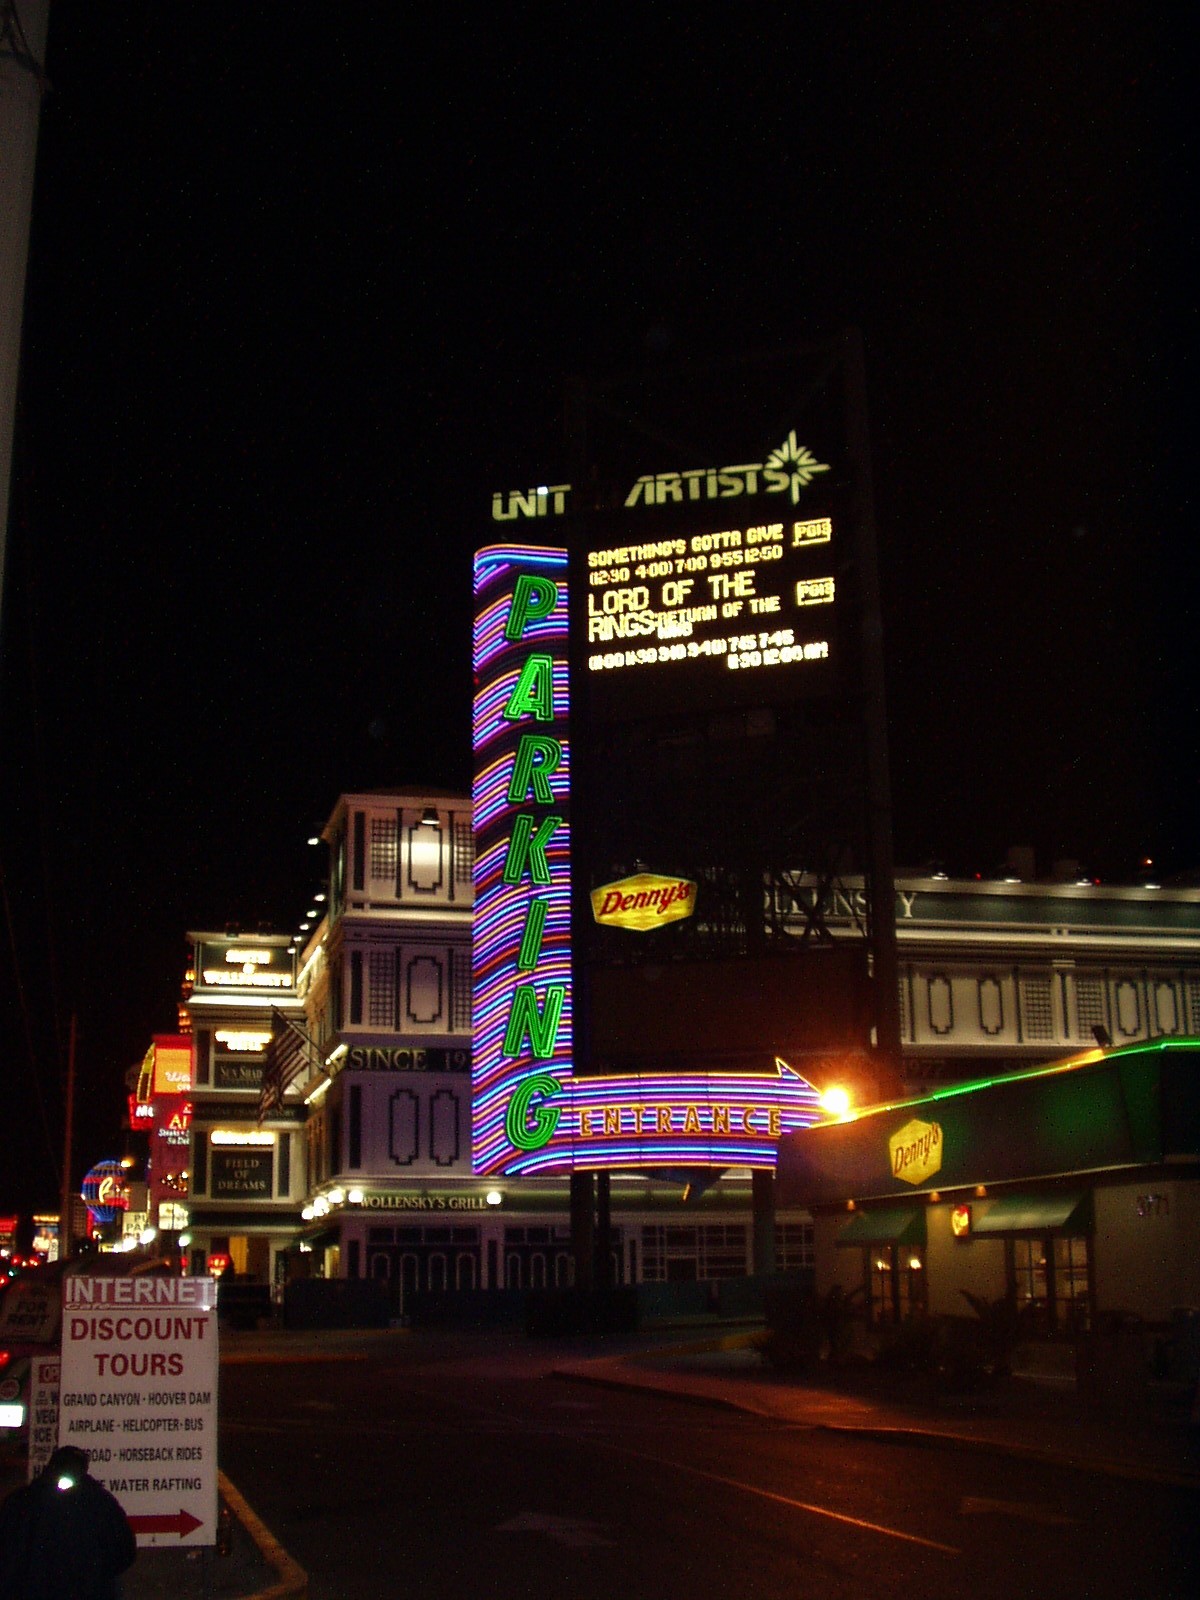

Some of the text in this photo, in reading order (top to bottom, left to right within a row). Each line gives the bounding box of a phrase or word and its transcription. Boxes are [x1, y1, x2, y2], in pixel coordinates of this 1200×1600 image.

[624, 462, 791, 508] ARTISTS
[588, 523, 783, 567] SOMETHING'S GOTTA GIVE
[675, 555, 708, 573] 7:00
[710, 550, 744, 568] 9:55
[744, 545, 783, 563] 12:50
[588, 570, 756, 617] LORD OF THE
[722, 601, 743, 618] OF
[749, 596, 781, 614] THE
[502, 572, 564, 1151] PARKING
[598, 881, 691, 916] Denny's
[349, 1050, 427, 1071] SINCE
[579, 1105, 782, 1137] ENTRANCE
[893, 1121, 941, 1176] Denny's
[225, 1158, 260, 1169] FIELD
[233, 1170, 249, 1180] OF
[217, 1180, 266, 1191] DREAMS
[448, 1198, 487, 1210] GRILL
[65, 1277, 215, 1304] INTERNET
[70, 1317, 209, 1341] DISCOUNT
[94, 1353, 184, 1376] TOURS
[64, 1393, 97, 1406] GRAND
[100, 1393, 141, 1406] CANYON
[148, 1393, 187, 1405] HOOVER
[189, 1392, 211, 1405] DAM
[68, 1418, 204, 1433] AIRPLANE HELICOPTER BUS
[119, 1447, 174, 1461] HORSEBACK
[176, 1446, 203, 1460] RIDES
[109, 1479, 150, 1492] WATER
[152, 1478, 202, 1491] RAFTING
